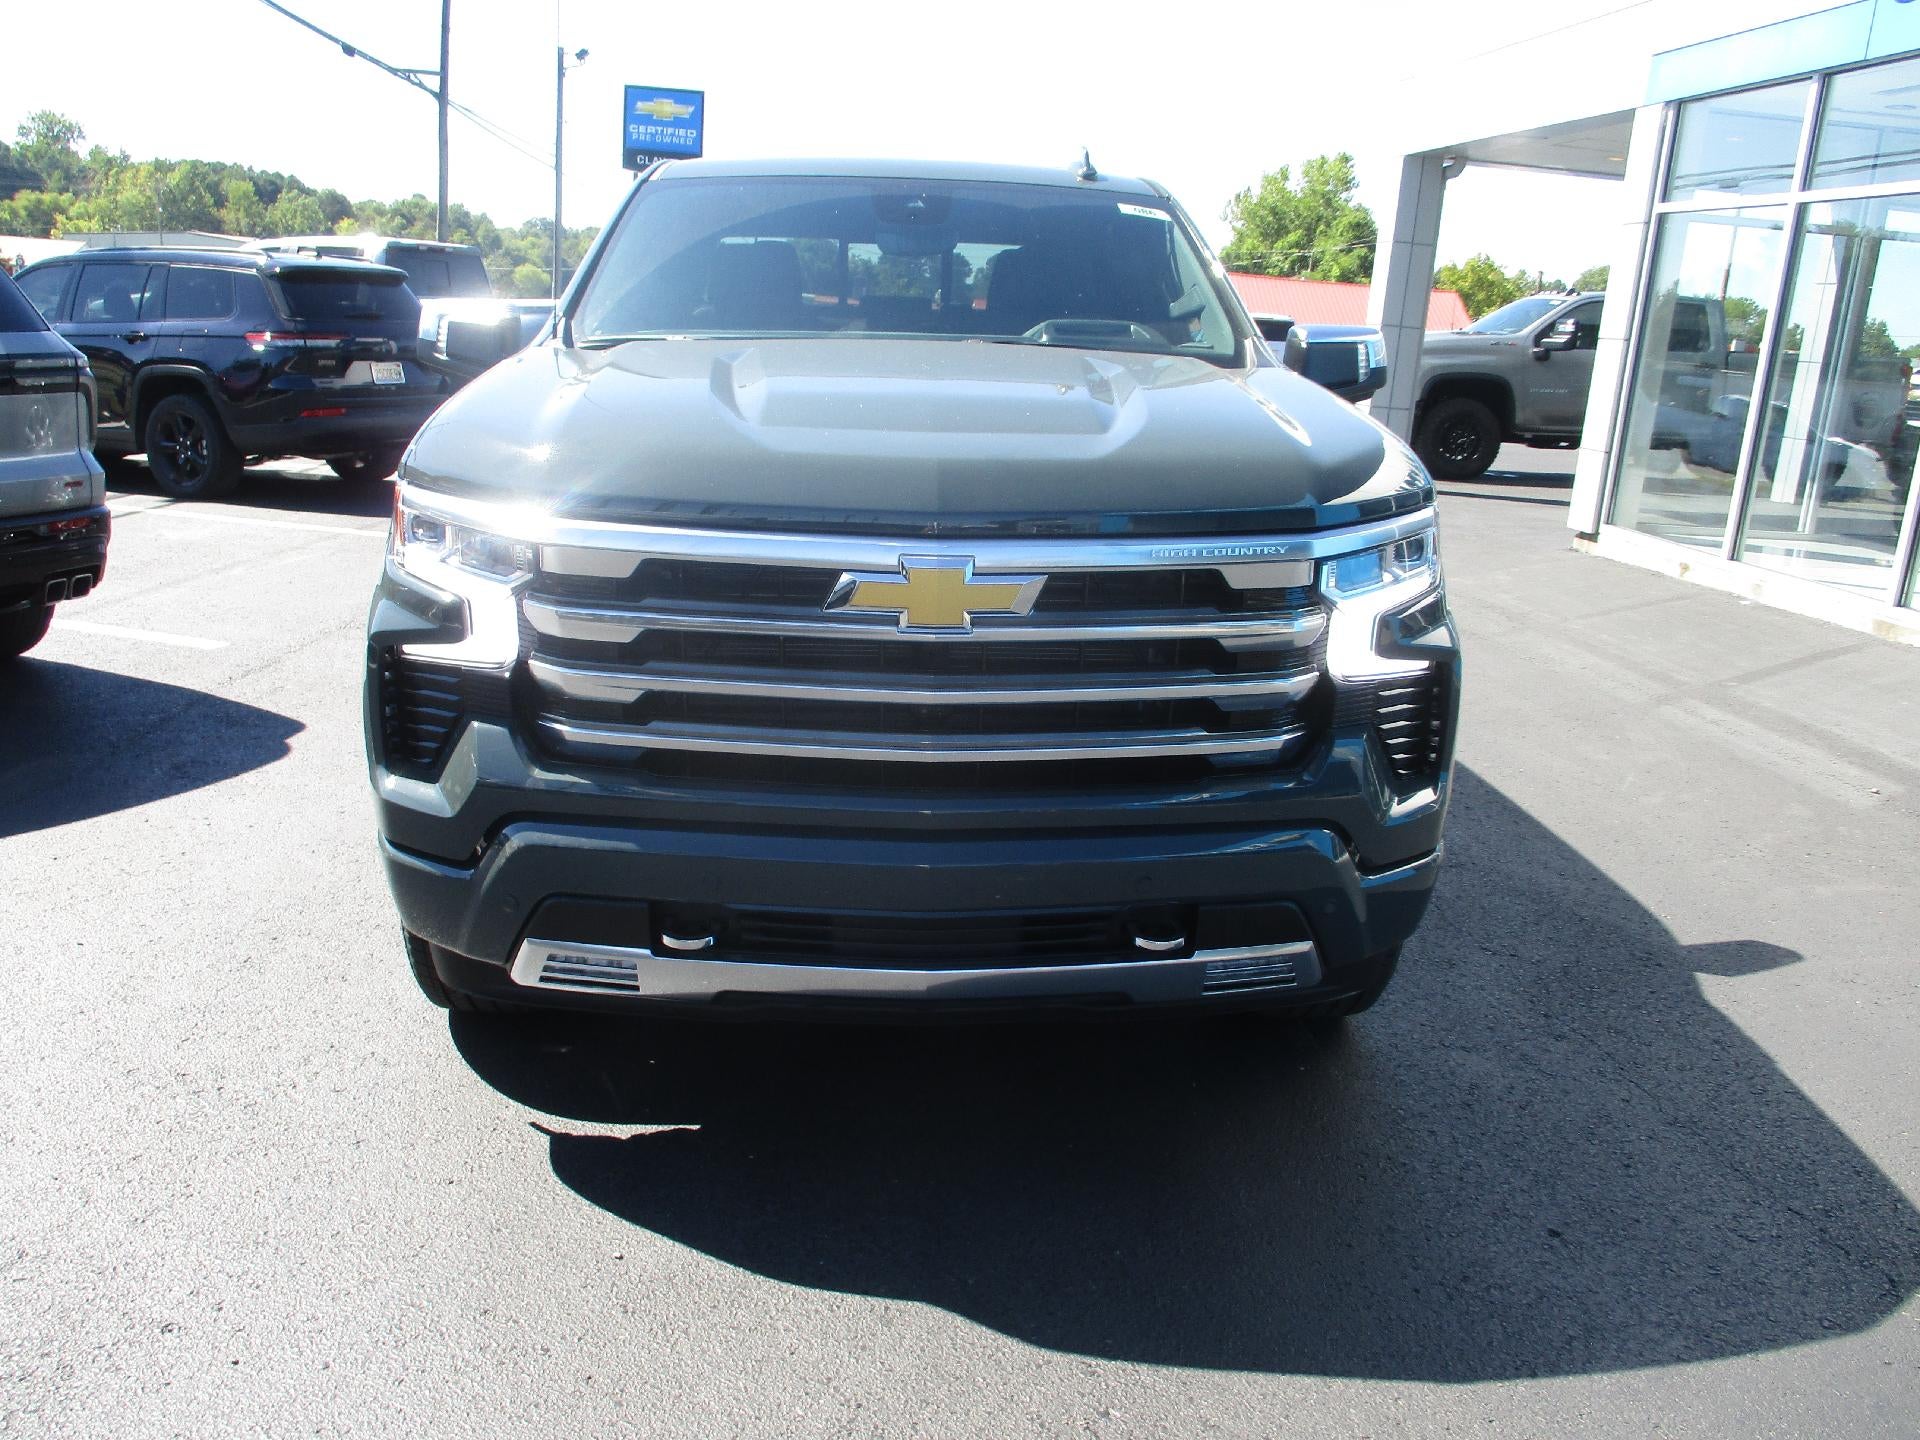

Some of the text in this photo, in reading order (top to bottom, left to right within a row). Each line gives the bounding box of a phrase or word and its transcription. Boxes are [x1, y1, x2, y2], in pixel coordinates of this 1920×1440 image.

[629, 124, 697, 137] CERTIFIED
[1152, 546, 1289, 557] HIGH COUNTRY
